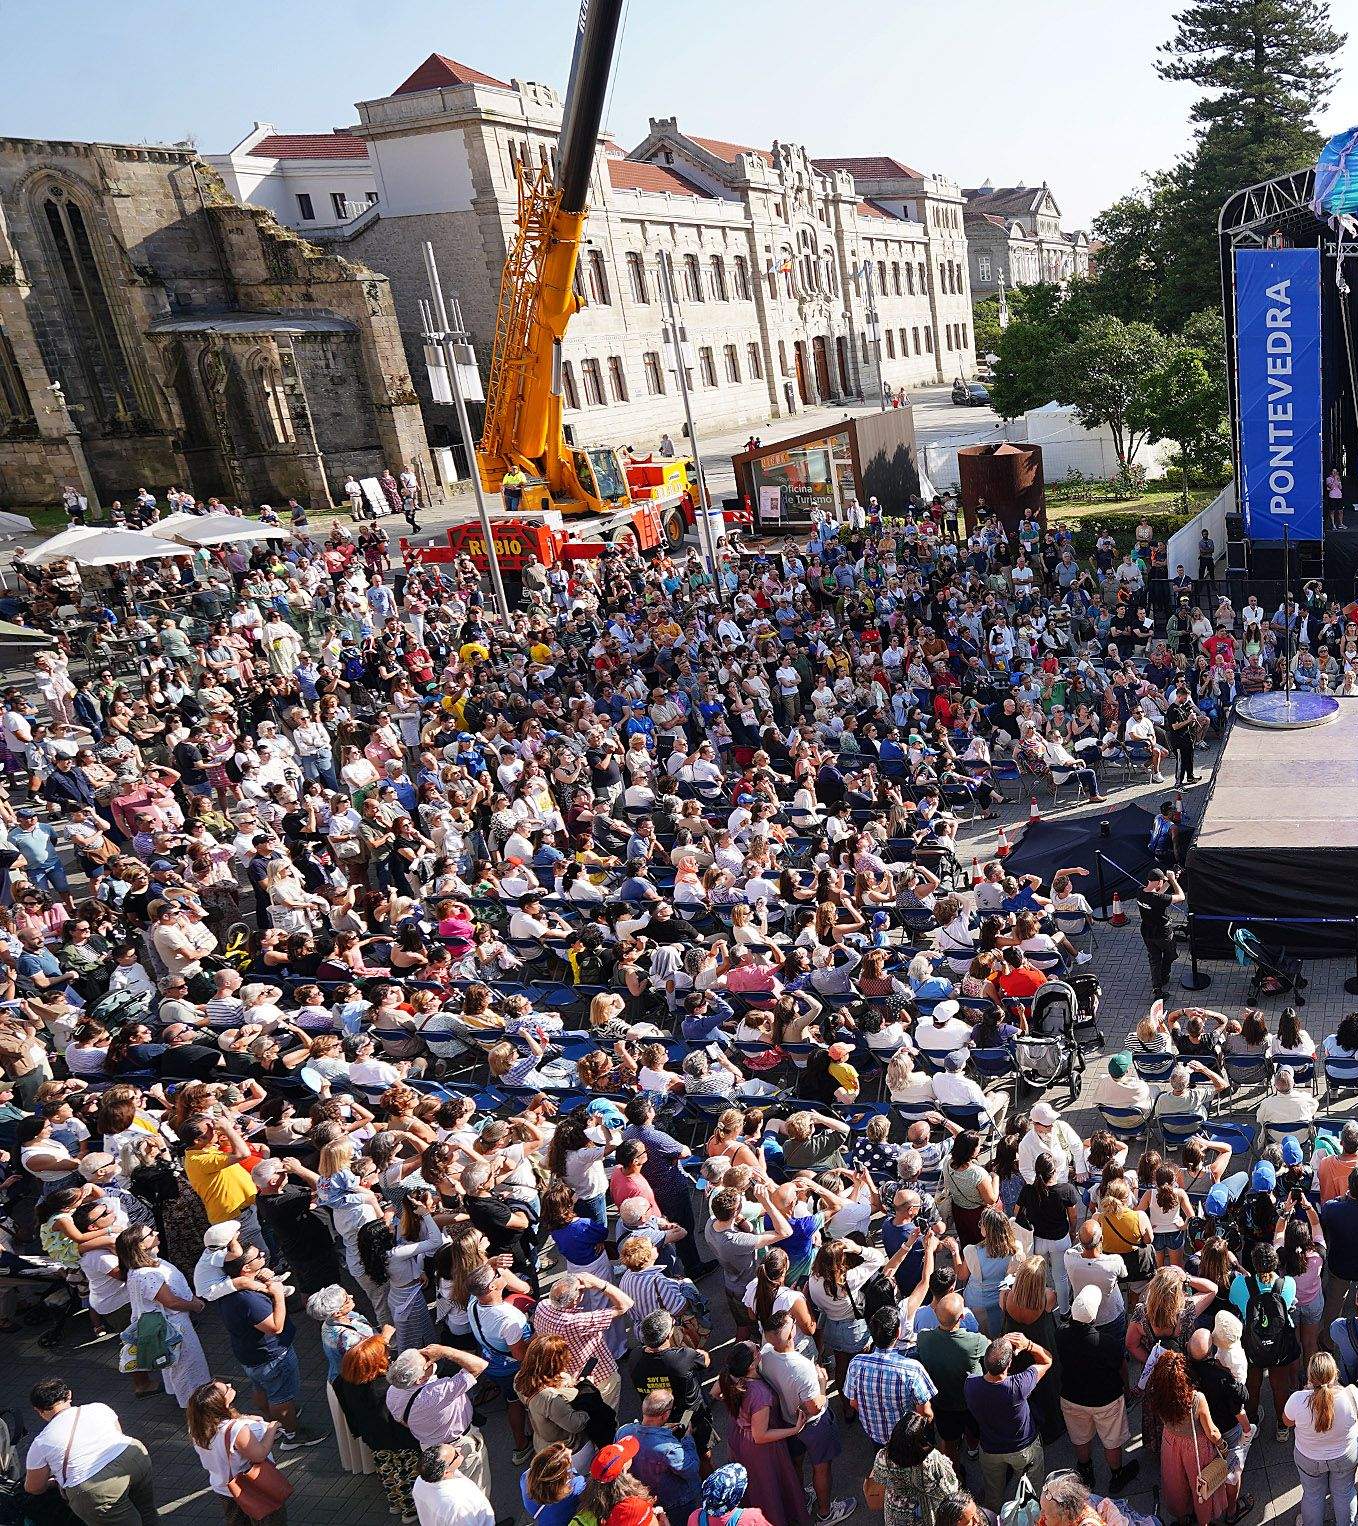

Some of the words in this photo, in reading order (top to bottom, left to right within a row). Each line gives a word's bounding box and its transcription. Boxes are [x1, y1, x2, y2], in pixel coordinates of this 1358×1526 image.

[1266, 279, 1294, 516] PONTEVEDRA
[781, 484, 813, 494] Oficina
[796, 495, 833, 504] Turismo
[468, 539, 522, 556] RUBIO
